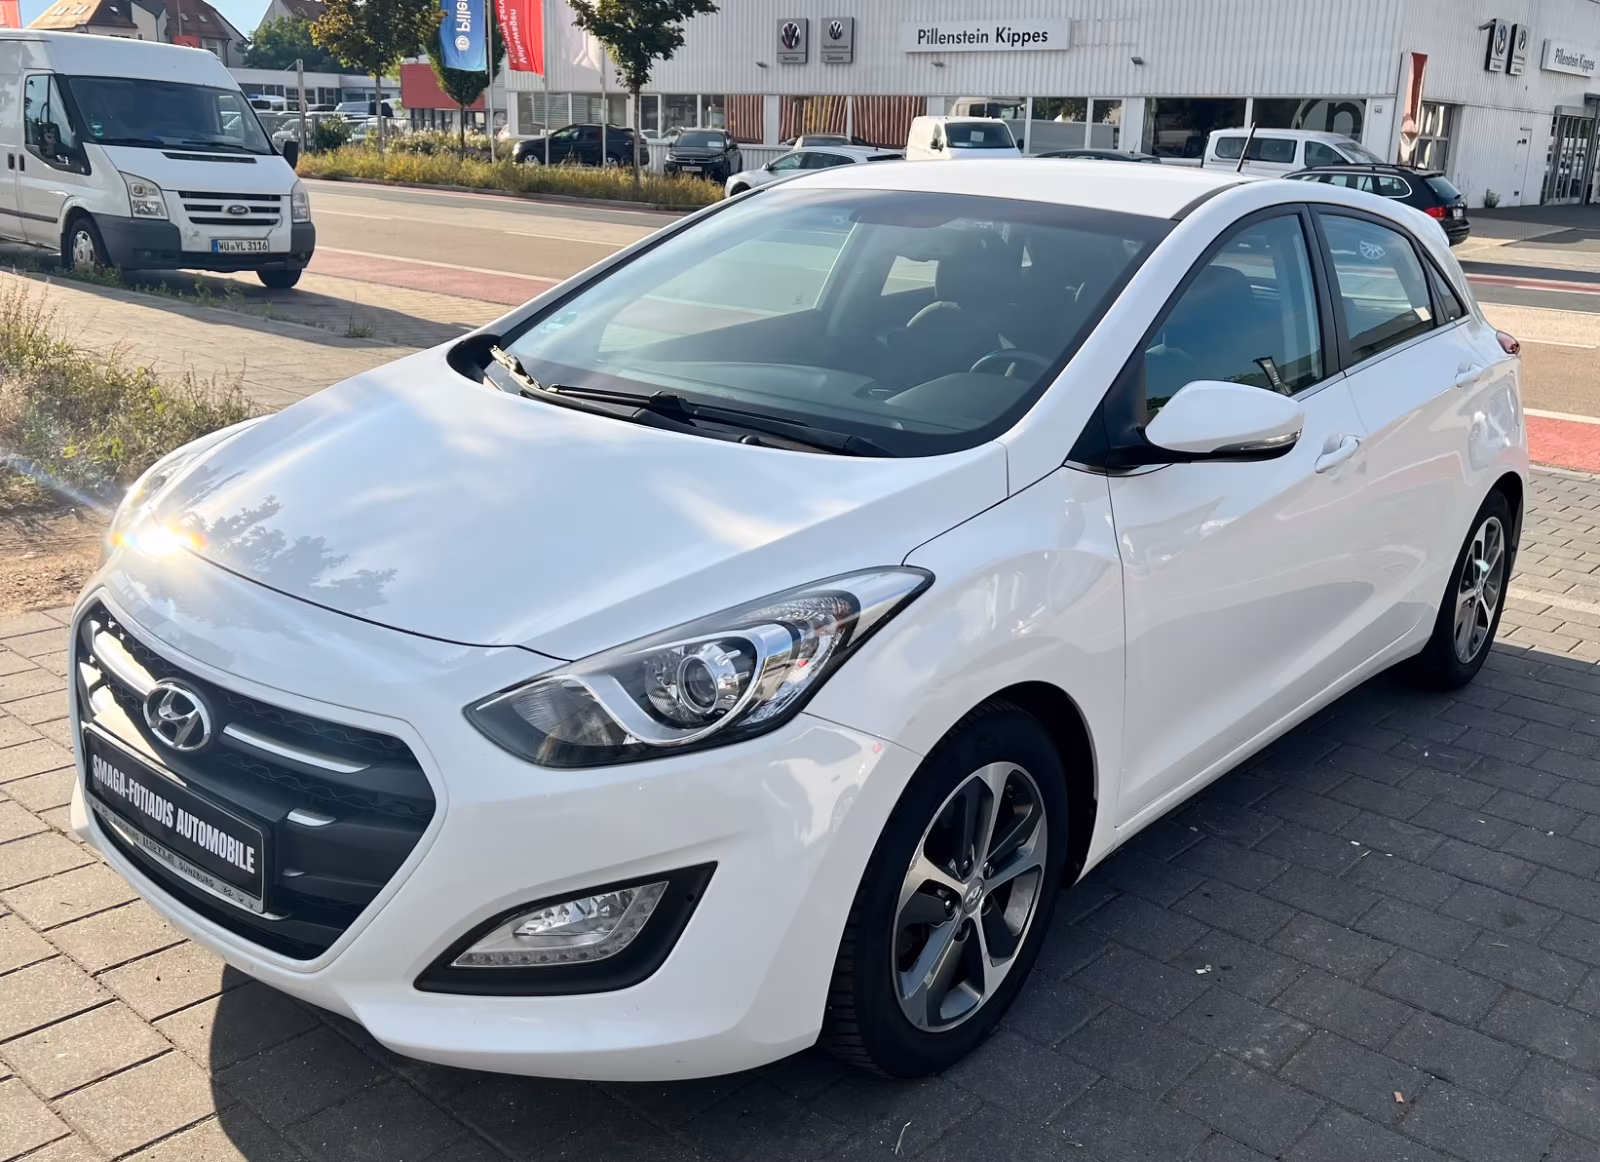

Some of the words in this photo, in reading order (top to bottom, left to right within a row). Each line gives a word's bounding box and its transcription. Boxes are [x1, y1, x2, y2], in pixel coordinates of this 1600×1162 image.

[917, 27, 989, 45] Pillenstein
[995, 26, 1049, 47] Kippes
[235, 241, 246, 251] YL
[248, 241, 268, 251] 3116
[92, 753, 174, 828] SMAGA-FOTIADIS
[176, 808, 256, 875] AUTOMOBILE
